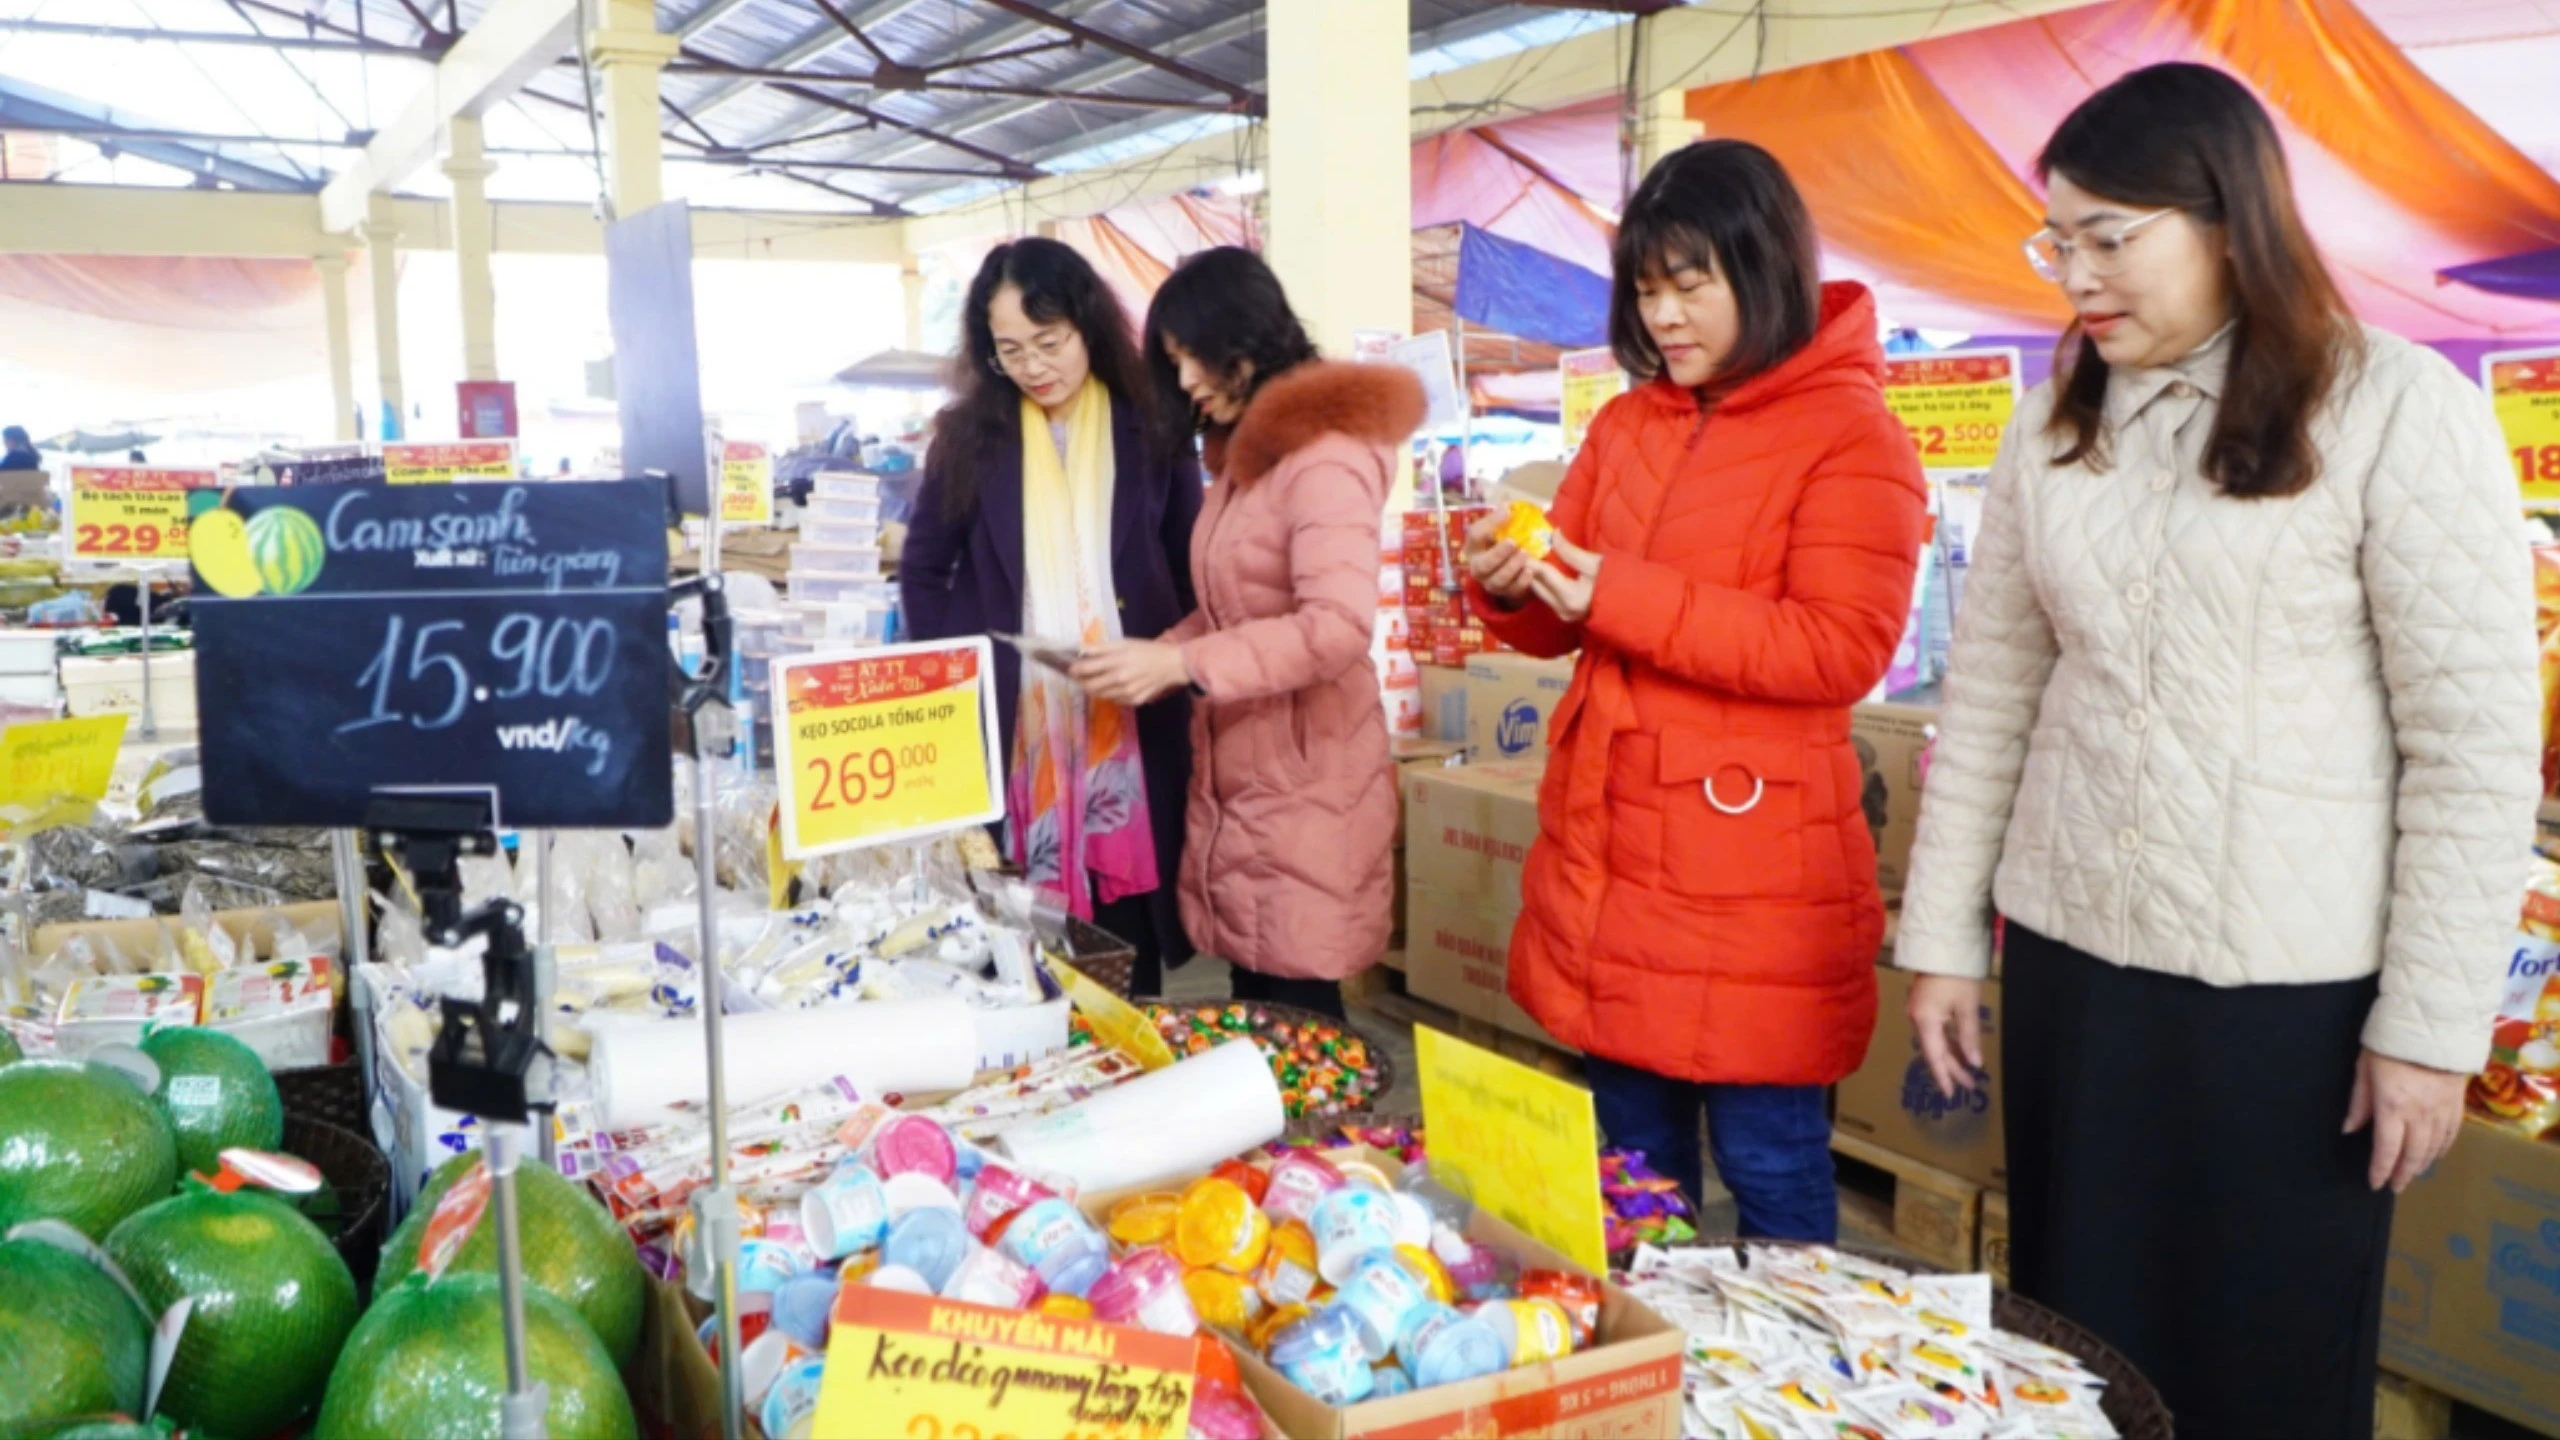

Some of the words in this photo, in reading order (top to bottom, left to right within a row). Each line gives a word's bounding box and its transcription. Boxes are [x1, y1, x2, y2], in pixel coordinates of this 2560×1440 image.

[76, 523, 161, 553] 229
[325, 488, 424, 552] Cam
[334, 612, 617, 731] 15.900
[799, 721, 828, 741] KẸO
[831, 714, 885, 736] SOCOLA
[888, 707, 925, 726] TỔNG
[928, 704, 957, 723] HỢP
[1500, 711, 1537, 747] Vim
[807, 747, 896, 812] 269
[930, 1304, 1056, 1349] KHUYẾN
[1559, 1391, 1579, 1414] KG
